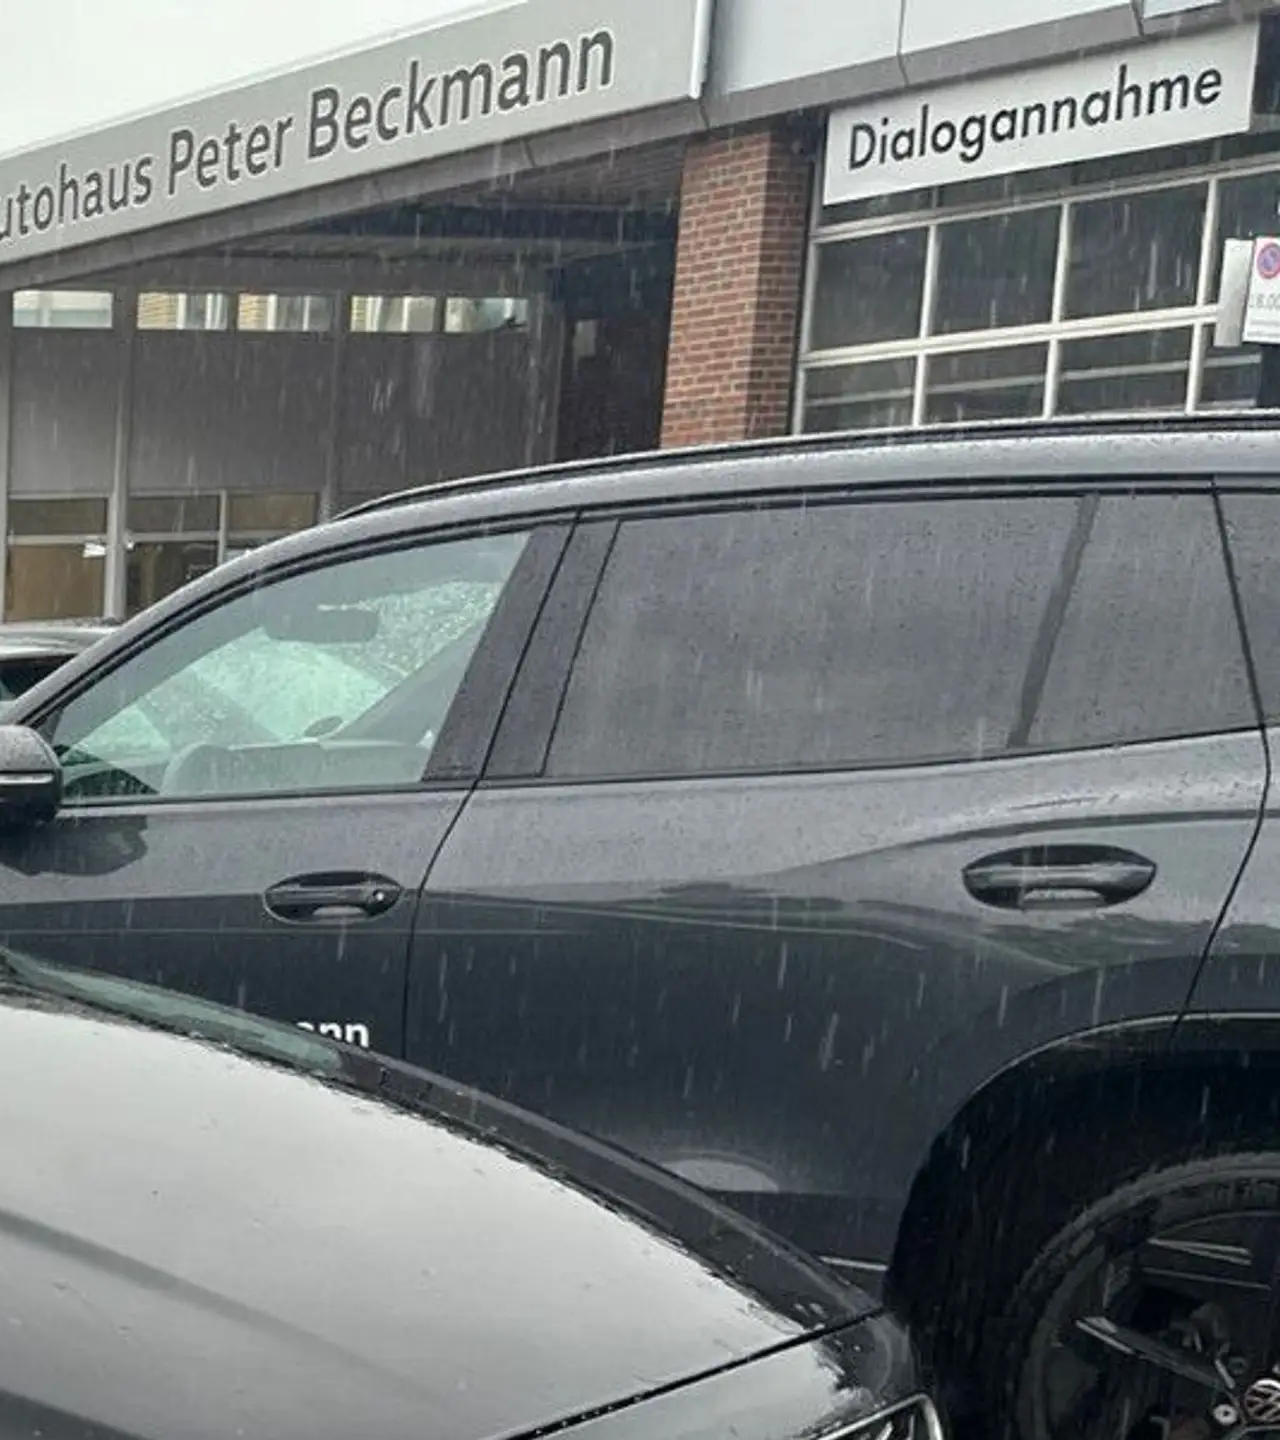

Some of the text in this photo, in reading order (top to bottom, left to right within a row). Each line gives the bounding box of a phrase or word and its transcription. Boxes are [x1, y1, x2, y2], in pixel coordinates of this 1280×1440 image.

[167, 115, 293, 196] Peter
[306, 26, 614, 159] Beckmann
[848, 62, 1222, 170] Dialogannahme
